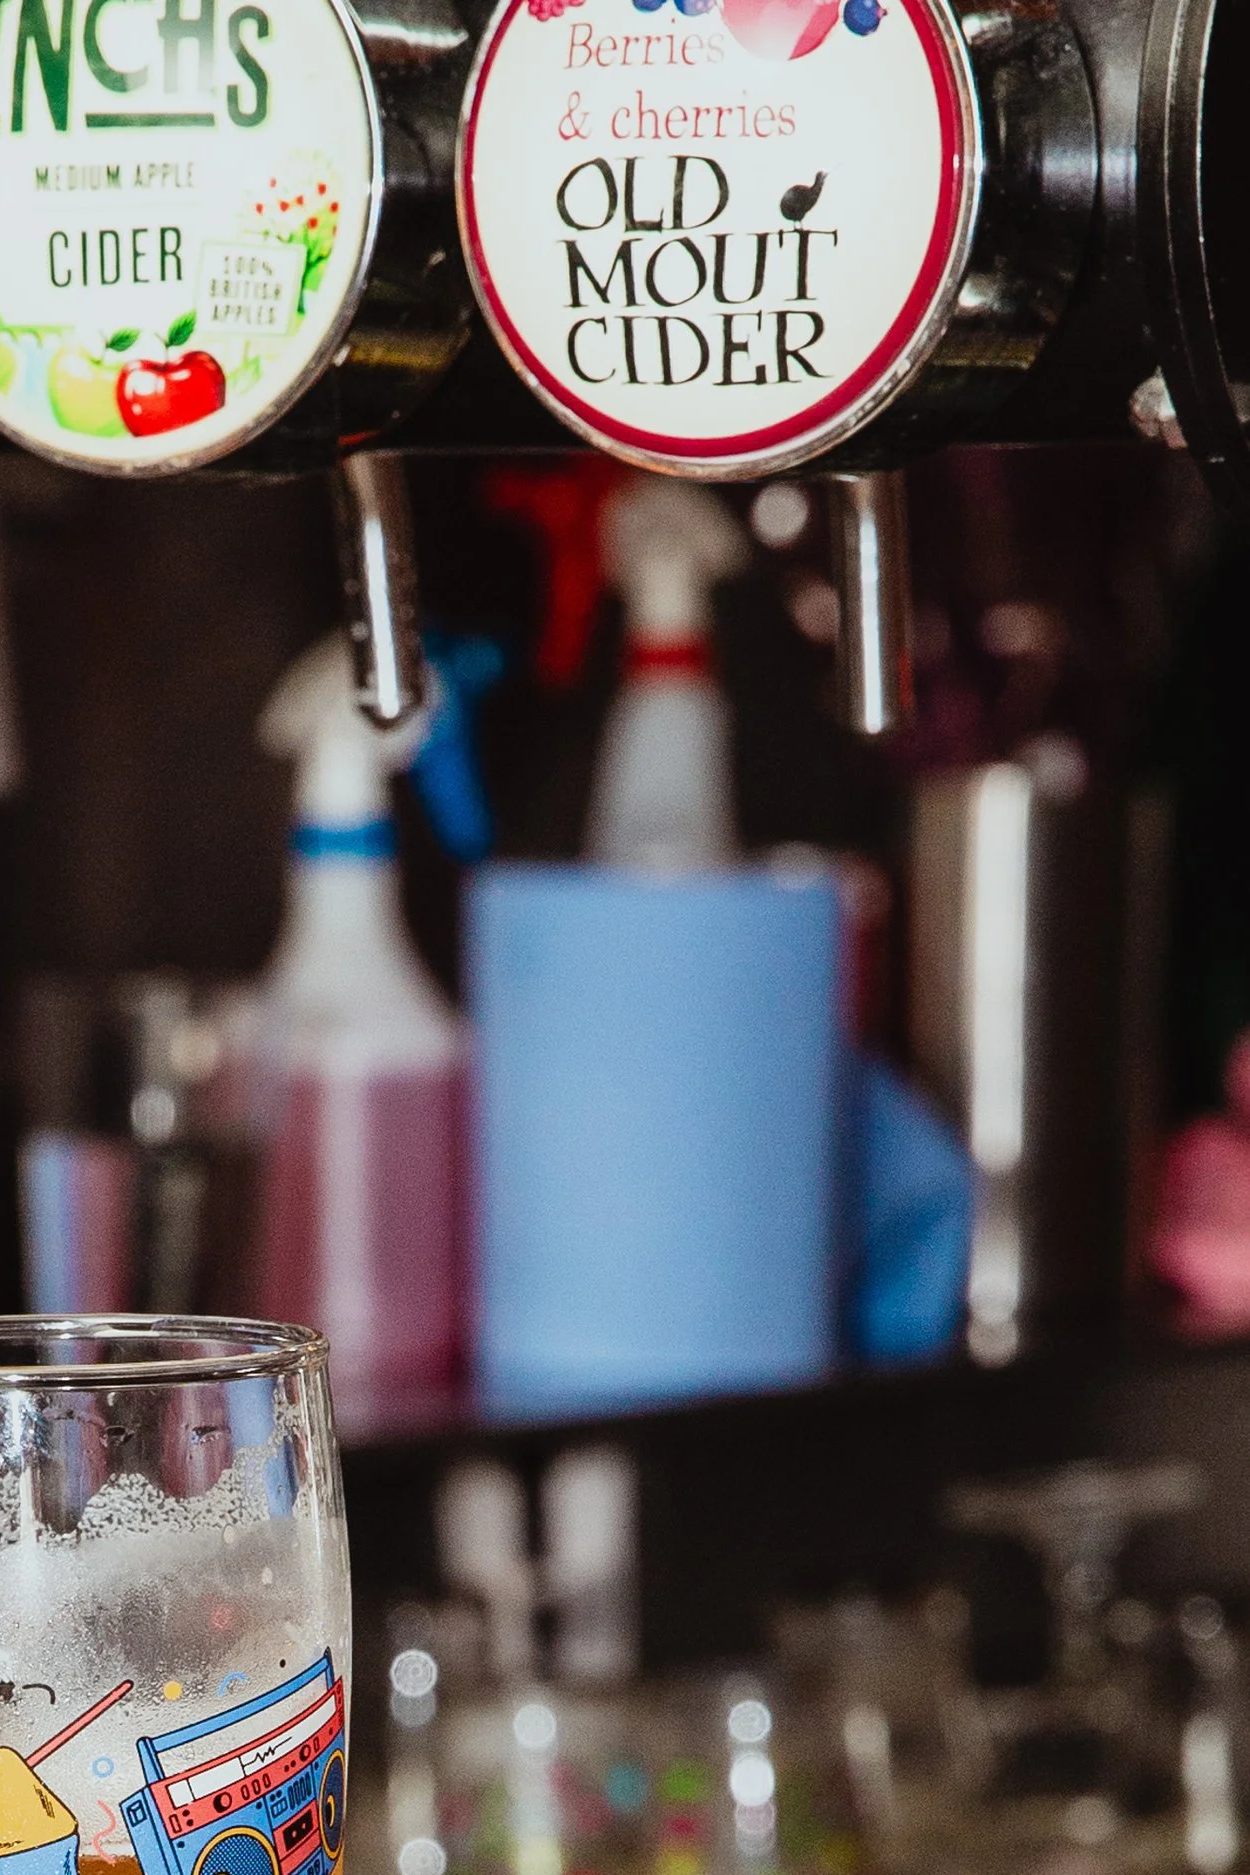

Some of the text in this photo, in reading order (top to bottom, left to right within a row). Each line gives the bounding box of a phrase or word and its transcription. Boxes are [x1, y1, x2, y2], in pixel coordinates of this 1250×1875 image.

[564, 18, 725, 69] Berries
[557, 89, 797, 142] & cherries
[34, 161, 195, 191] MEDIUM APPLE
[555, 154, 730, 233] OLD
[49, 225, 184, 289] CIDER
[556, 228, 838, 309] MOUT
[565, 310, 835, 387] CIDER
